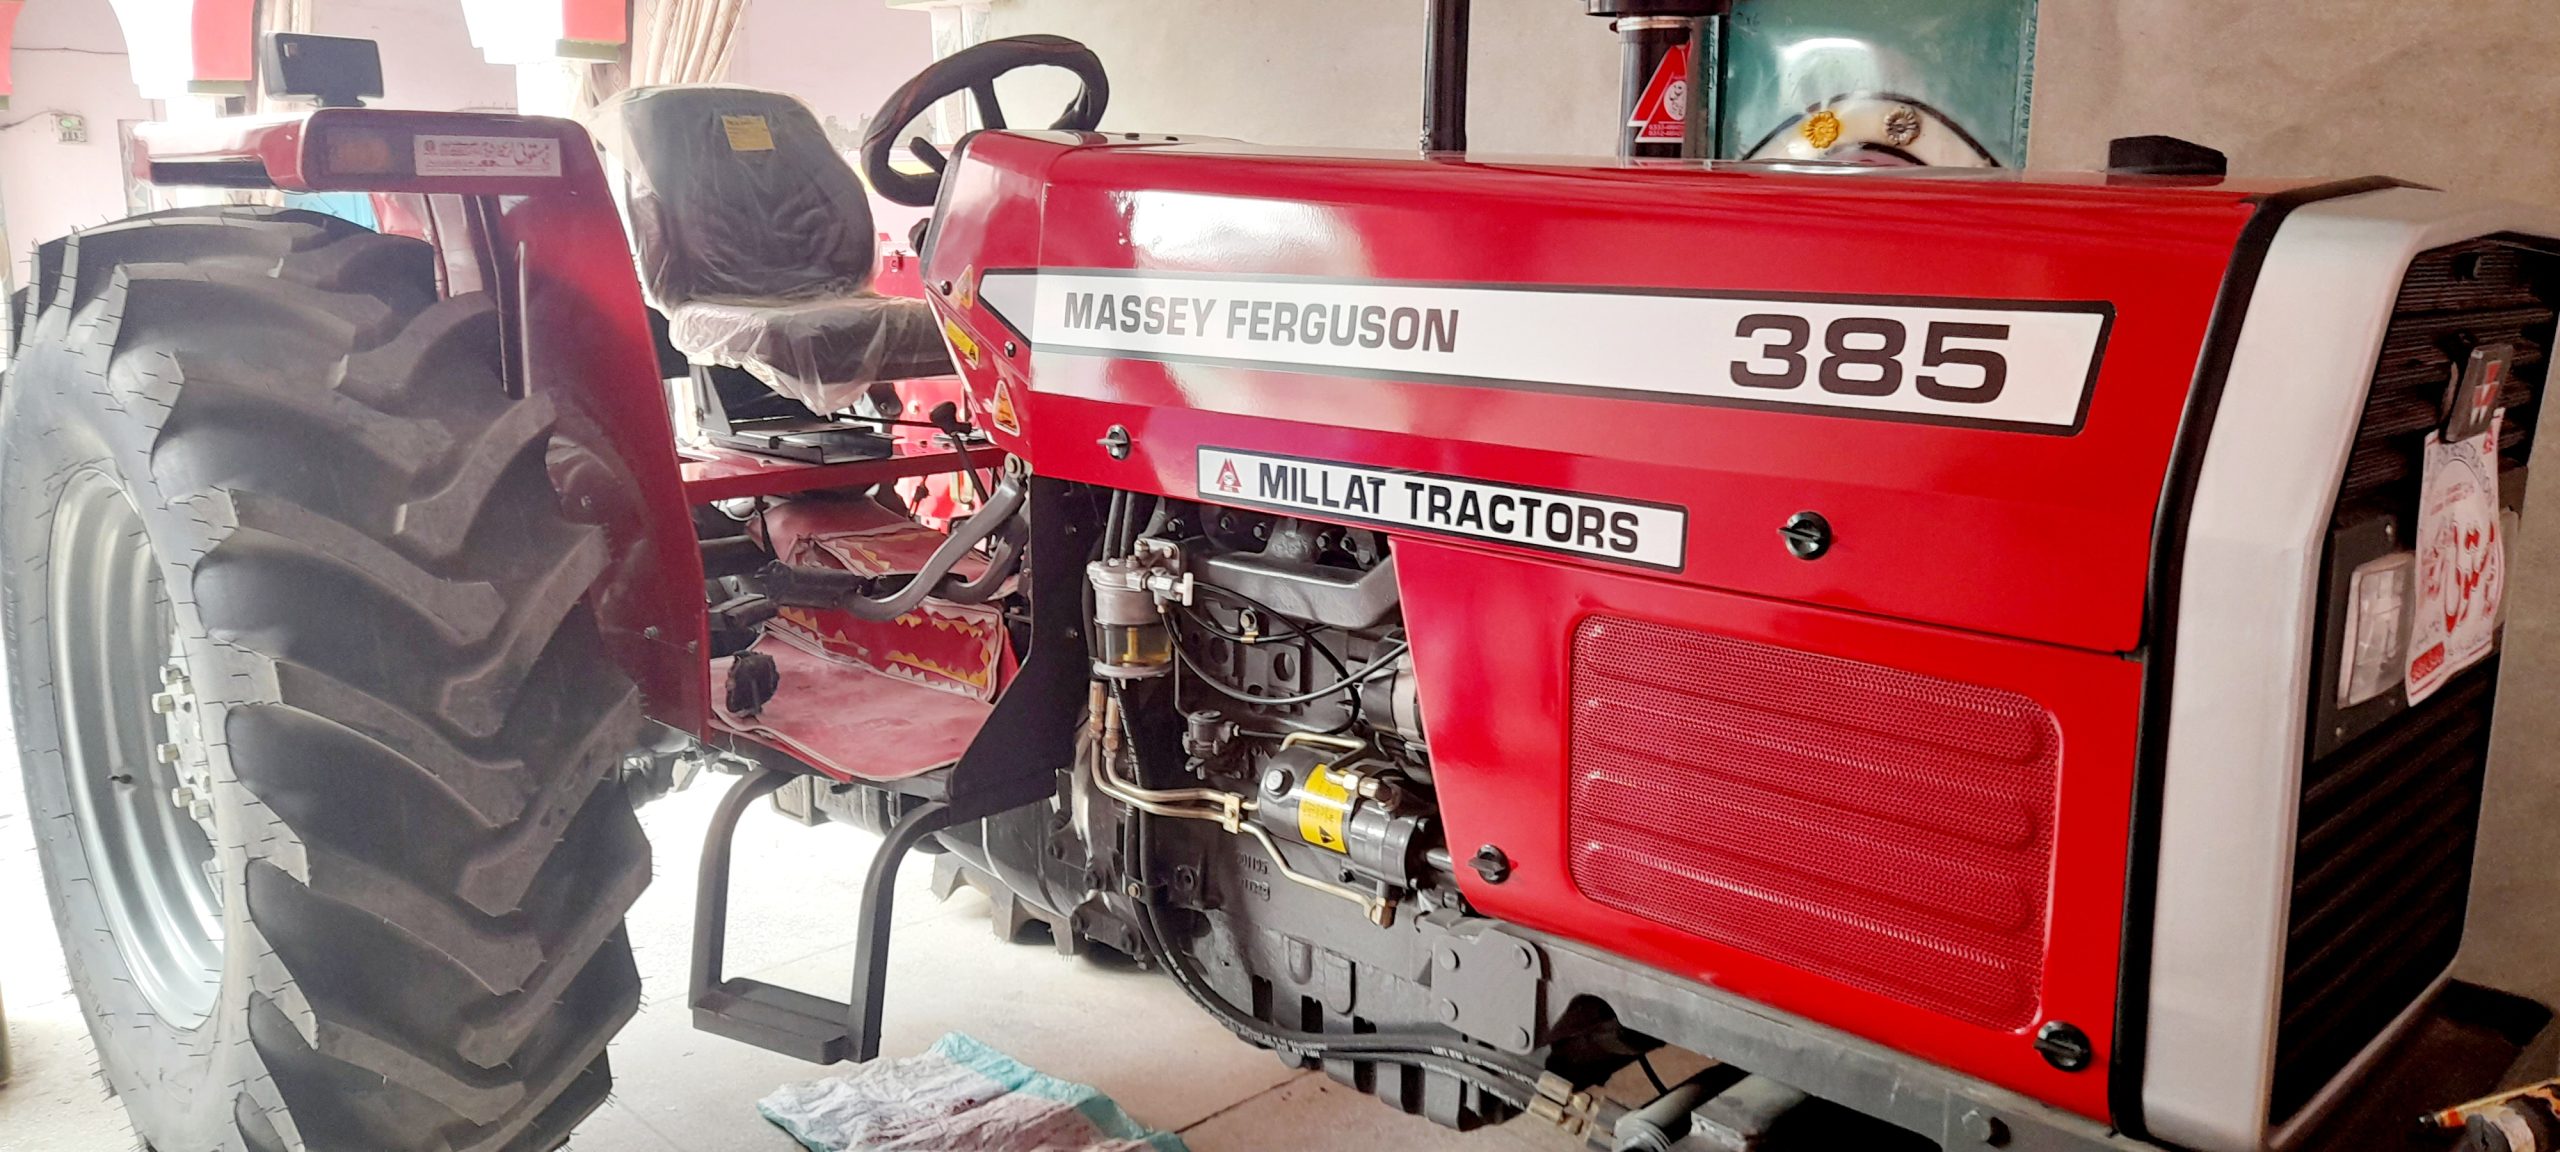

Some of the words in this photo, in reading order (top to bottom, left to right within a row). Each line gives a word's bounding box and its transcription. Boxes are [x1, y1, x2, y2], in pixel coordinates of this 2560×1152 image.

[1063, 292, 1217, 338] MASSEY
[1226, 299, 1460, 354] FERGUSON
[1730, 313, 2010, 404] 385
[1259, 462, 1386, 515] MILLAT
[1404, 481, 1640, 555] TRACTORS
